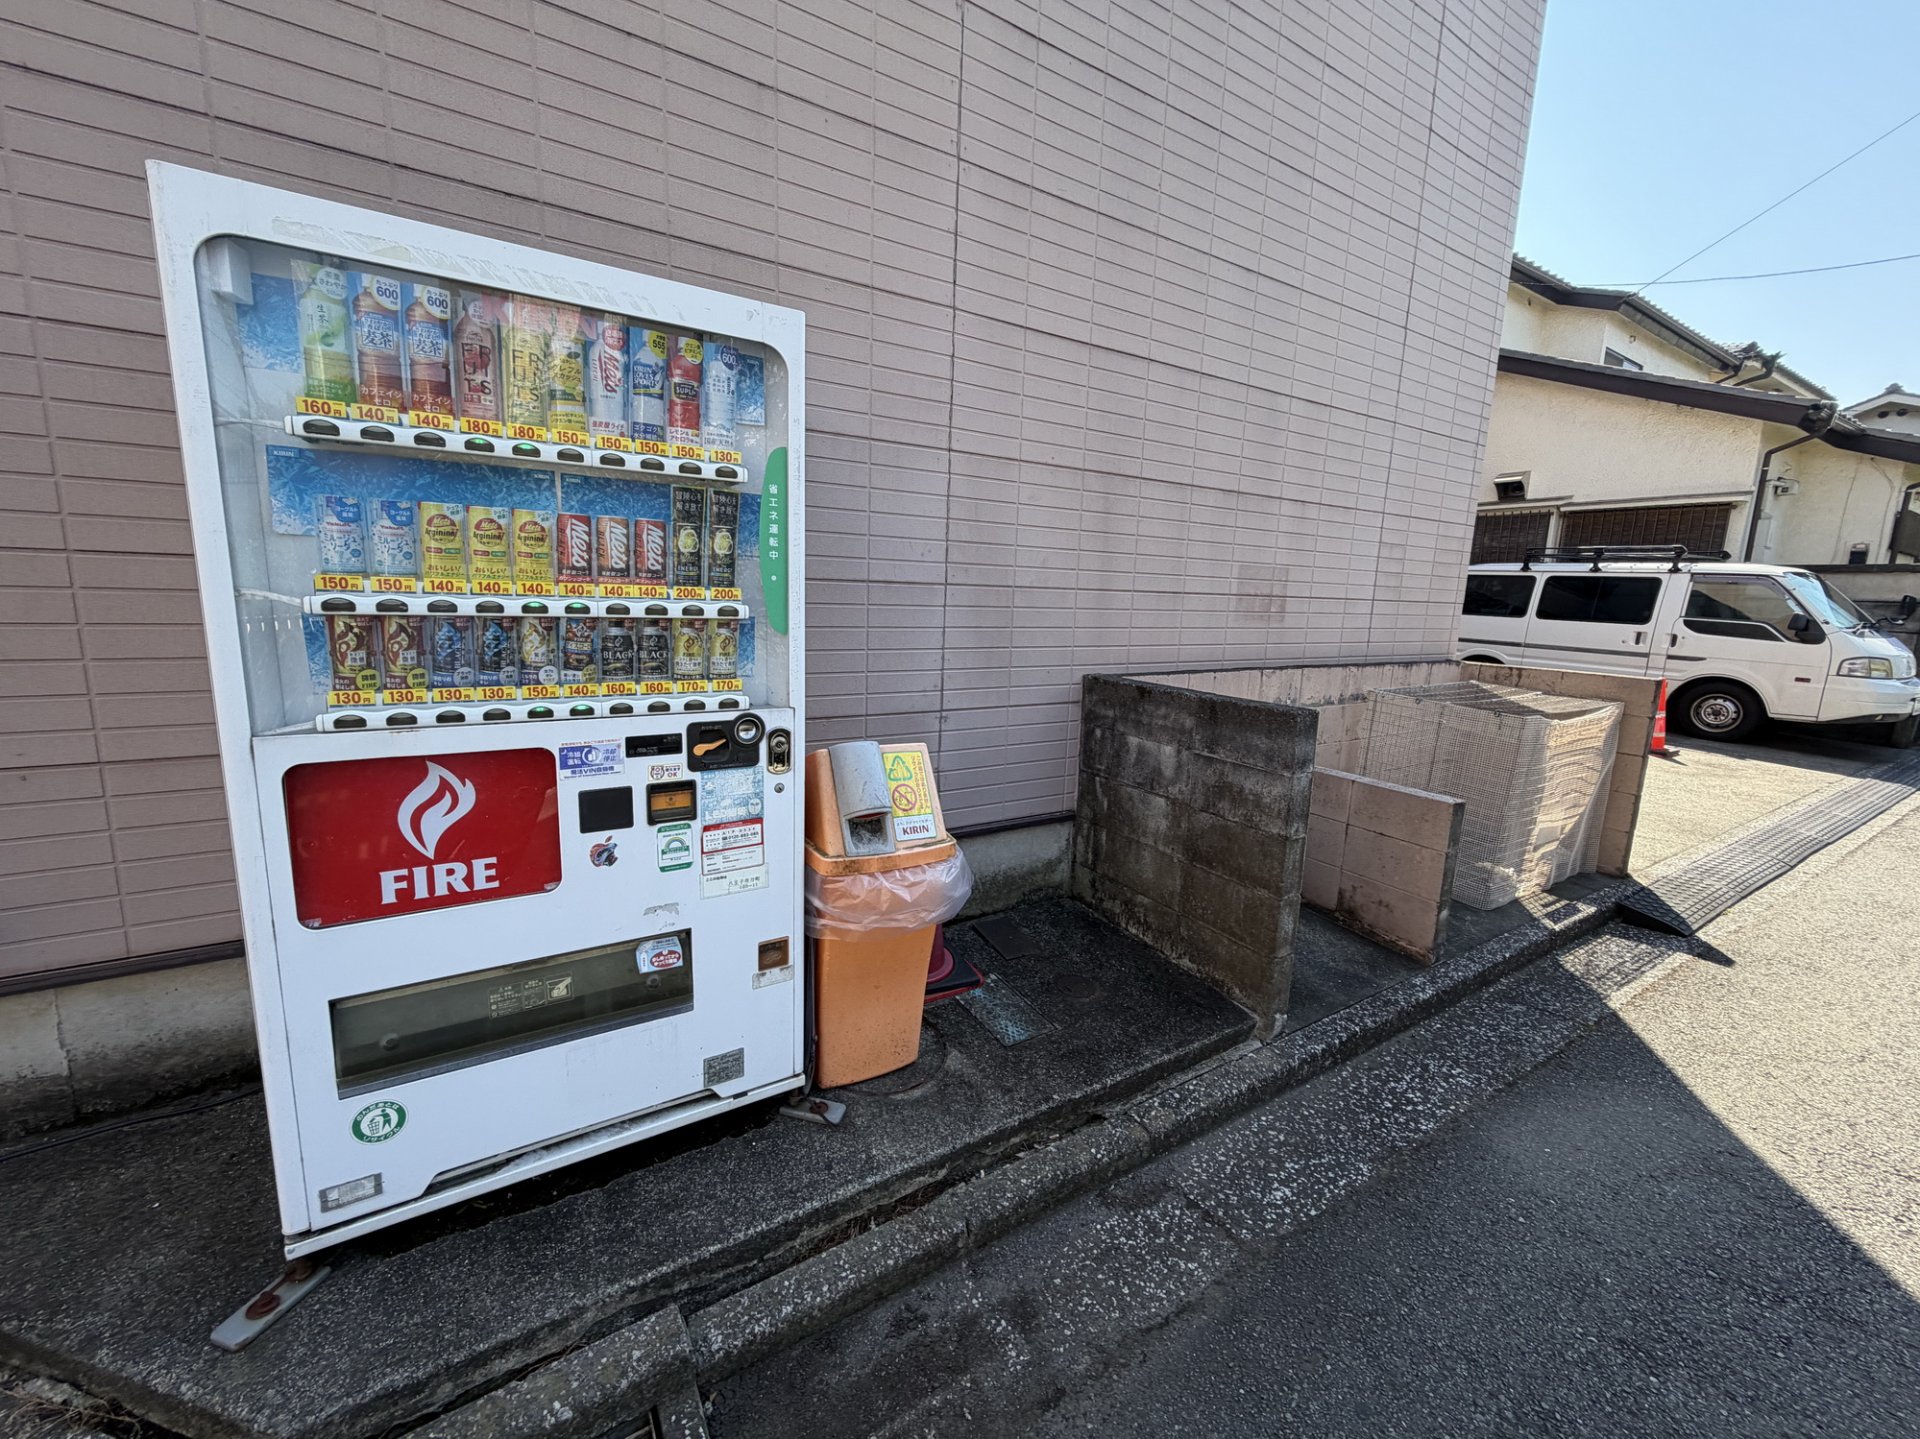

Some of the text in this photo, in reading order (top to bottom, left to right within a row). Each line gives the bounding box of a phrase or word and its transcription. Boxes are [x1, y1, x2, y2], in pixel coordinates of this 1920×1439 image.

[376, 286, 399, 301] 600
[426, 295, 449, 311] 600
[652, 339, 666, 350] 555
[721, 353, 736, 365] 600
[361, 385, 402, 398] カフェイン
[374, 398, 391, 406] ゼロ
[413, 393, 451, 405] カフェイン
[302, 399, 342, 417] 160円
[356, 405, 395, 423] 140円
[423, 403, 440, 413] ゼロ
[415, 413, 450, 429] 140円
[465, 419, 499, 435] 180円
[633, 422, 657, 433] ゴクゴク
[511, 424, 544, 440] 180円
[556, 430, 587, 445] 150円
[600, 436, 629, 451] 150円
[639, 441, 667, 455] 150円
[675, 445, 701, 458] 150円
[714, 450, 739, 463] 130円
[768, 484, 779, 560] 省エネ運転中
[571, 518, 590, 568] Mets
[610, 520, 628, 569] Mets
[647, 524, 665, 571] Mets
[320, 576, 359, 590] 150円
[376, 578, 412, 591] 150円
[429, 579, 463, 593] 140円
[477, 581, 510, 594] 140円
[521, 582, 552, 595] 140円
[563, 584, 593, 596] 140円
[603, 585, 631, 597] 140円
[637, 586, 665, 598] 140円
[675, 587, 703, 599] 200円
[713, 588, 739, 600] 200円
[526, 686, 556, 698] 150円
[568, 685, 597, 696] 140円
[605, 683, 633, 695] 160円
[644, 682, 671, 693] 160円
[681, 681, 705, 692] 170円
[716, 680, 740, 691] 170円
[334, 692, 371, 705] 130円
[388, 690, 424, 703] 130円
[438, 688, 471, 701] 130円
[481, 687, 514, 700] 130円
[901, 824, 930, 836] KIRIN
[378, 856, 500, 906] FIRE
[363, 1126, 401, 1142] リサイクル
